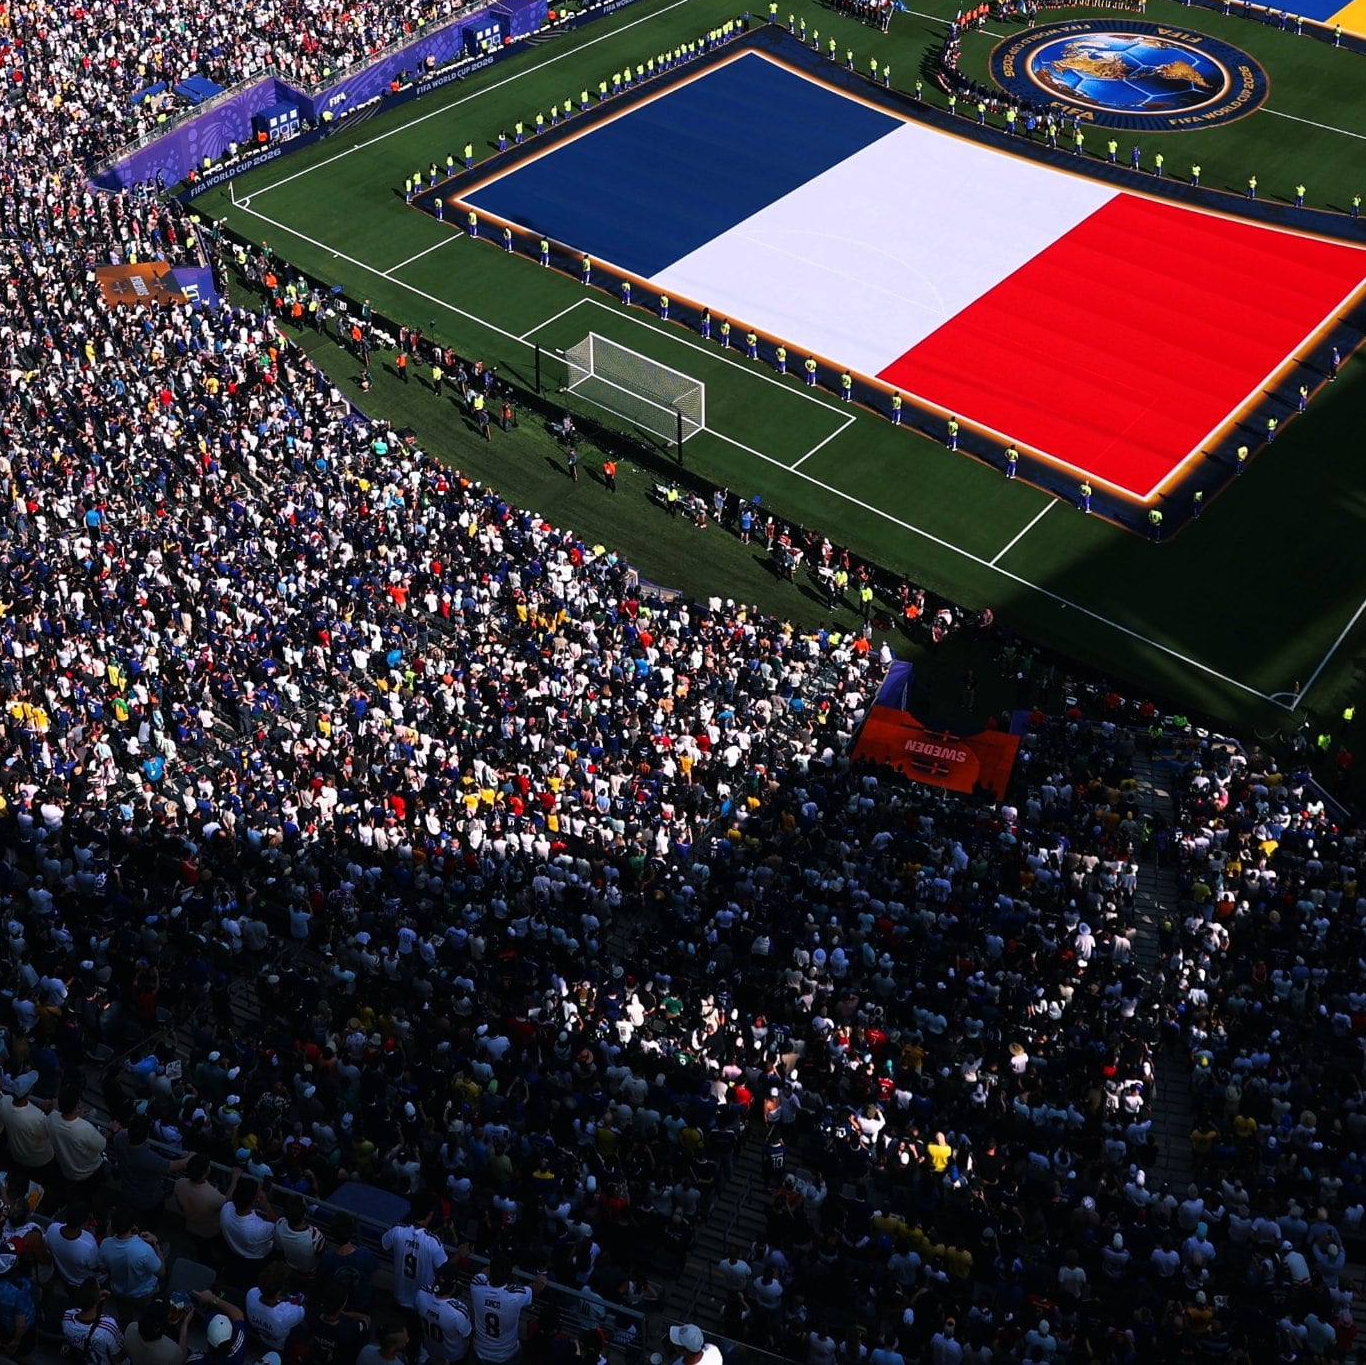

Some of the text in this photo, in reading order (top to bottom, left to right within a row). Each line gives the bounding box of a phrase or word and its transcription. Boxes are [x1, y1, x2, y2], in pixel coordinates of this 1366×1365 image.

[603, 4, 614, 14] FIFA
[1156, 26, 1204, 44] FIFA
[417, 55, 494, 95] FIFA WORLD CUP 2026
[329, 92, 346, 108] FIFA
[1168, 65, 1255, 126] FIFA WORLD CUP 2026
[1049, 101, 1095, 121] FIFA
[190, 147, 282, 198] FIFA WORLD CUP 2026
[904, 738, 968, 763] SWEDEN
[403, 1253, 418, 1279] 9
[485, 1312, 501, 1338] 8
